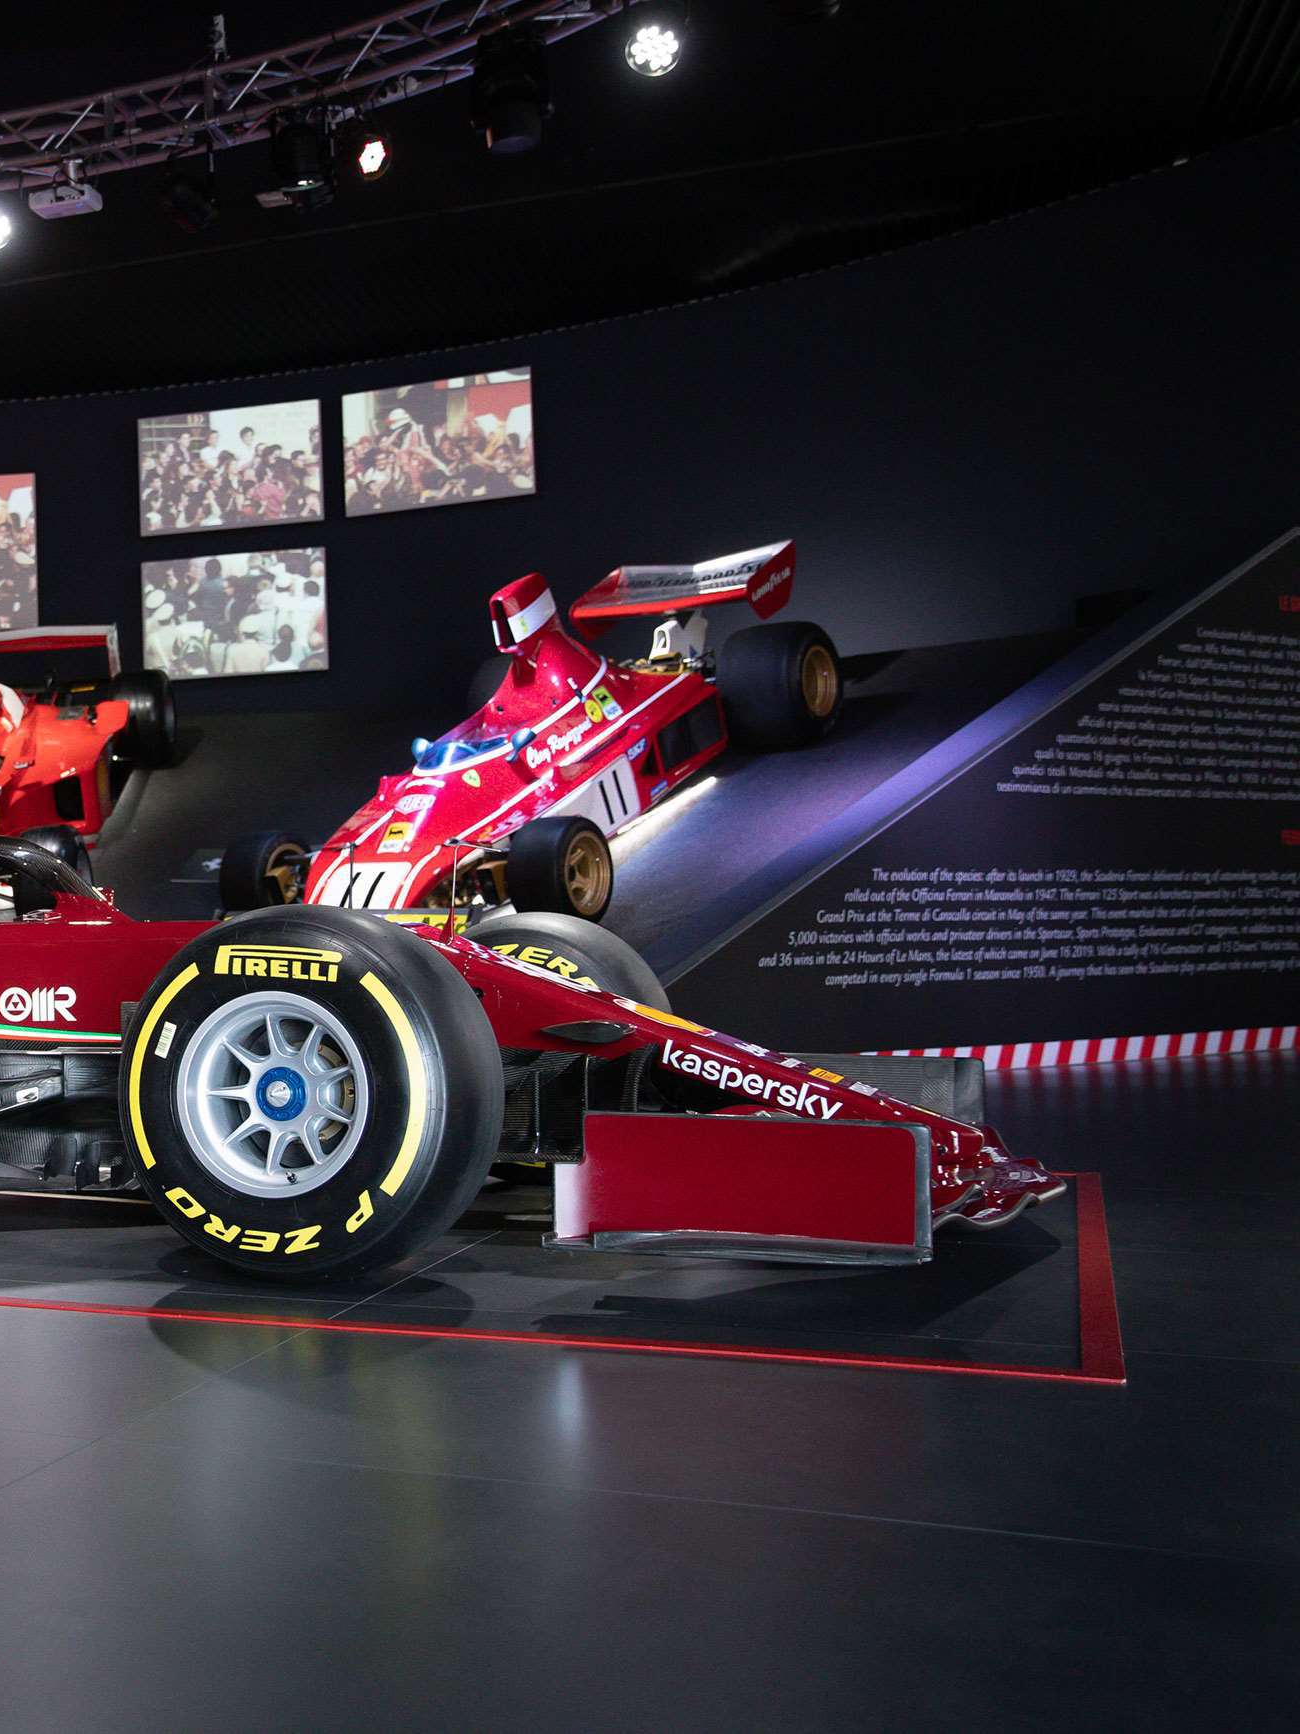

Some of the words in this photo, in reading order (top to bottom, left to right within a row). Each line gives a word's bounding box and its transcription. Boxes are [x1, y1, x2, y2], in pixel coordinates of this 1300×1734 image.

[599, 769, 628, 824] 11
[871, 868, 890, 881] The
[890, 867, 928, 882] evolution
[929, 867, 941, 884] of
[940, 867, 954, 882] the
[985, 867, 1006, 884] after
[1006, 868, 1017, 882] its
[1017, 867, 1044, 882] launch
[1044, 868, 1055, 882] in
[844, 888, 871, 902] rolled
[870, 890, 886, 902] out
[886, 888, 898, 905] of
[896, 888, 910, 902] the
[912, 887, 945, 905] Officina
[946, 887, 973, 902] Ferrari
[974, 888, 983, 902] in
[984, 888, 1023, 902] Maranello
[1025, 888, 1034, 901] in
[816, 909, 846, 924] Grand
[846, 908, 865, 923] Prix
[866, 910, 877, 922] at
[877, 908, 893, 922] the
[893, 908, 921, 922] Terme
[921, 908, 931, 922] di
[932, 907, 971, 922] Caracalla
[971, 908, 997, 921] circuit
[997, 908, 1006, 921] in
[1007, 907, 1025, 925] May
[1025, 907, 1037, 923] of
[1036, 907, 1049, 921] the
[1049, 910, 1070, 921] same
[788, 931, 818, 947] 5,000
[818, 929, 854, 944] victories
[854, 929, 875, 943] with
[876, 928, 906, 944] official
[906, 928, 931, 942] works
[931, 928, 949, 942] and
[949, 928, 986, 944] privateer
[986, 927, 1013, 940] drivers
[1013, 927, 1023, 940] in
[1023, 926, 1037, 940] the
[214, 944, 343, 983] PIRELLI
[758, 951, 778, 967] and
[778, 952, 793, 968] 36
[793, 951, 814, 966] wins
[815, 951, 825, 966] in
[826, 950, 841, 965] the
[842, 950, 856, 965] 24
[857, 949, 885, 964] Hours
[885, 948, 897, 965] of
[896, 949, 908, 963] Le
[908, 947, 935, 963] Mans,
[935, 947, 950, 961] the
[950, 947, 974, 961] latest
[974, 946, 985, 963] of
[984, 946, 1007, 960] which
[1007, 949, 1029, 960] came
[1028, 948, 1040, 960] on
[825, 969, 868, 988] competed
[868, 969, 878, 984] in
[879, 972, 903, 987] every
[903, 968, 928, 986] single
[928, 967, 965, 981] Formula
[966, 967, 972, 980] 1
[972, 969, 1000, 981] season
[1000, 967, 1022, 980] since
[662, 1039, 844, 1119] kaspersky
[164, 1186, 323, 1256] ZERO
[345, 1189, 375, 1234] P
